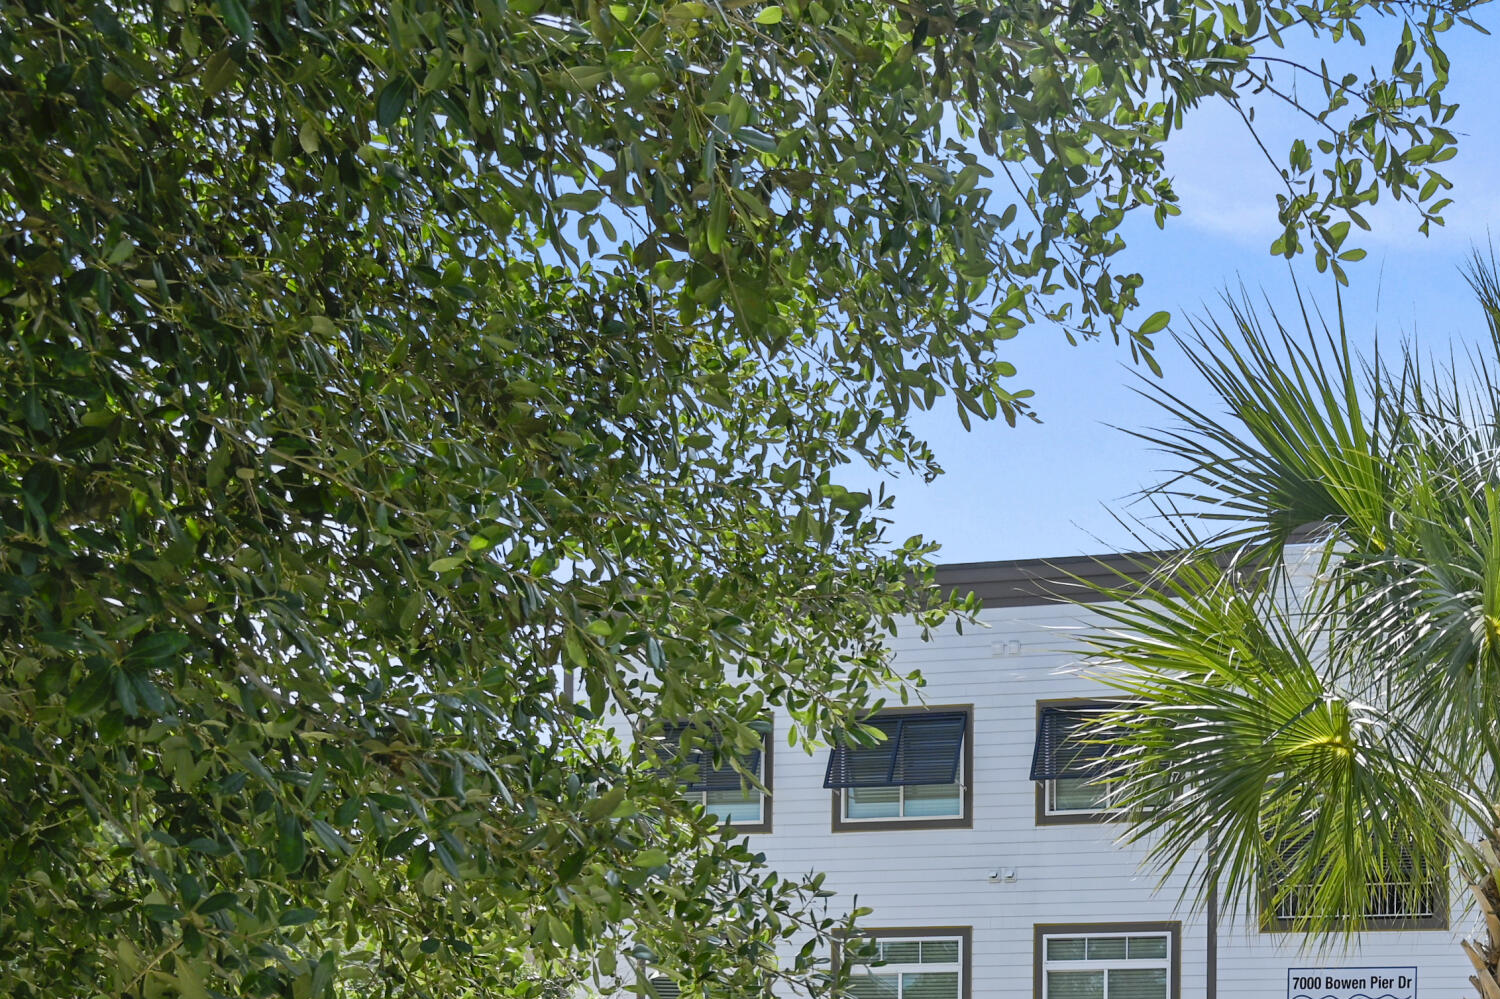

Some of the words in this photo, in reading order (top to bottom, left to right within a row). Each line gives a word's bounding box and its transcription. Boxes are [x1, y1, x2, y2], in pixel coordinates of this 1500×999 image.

[1292, 977, 1321, 989] 7000
[1325, 976, 1366, 989] Bowen
[1370, 976, 1394, 989] Pier
[1398, 975, 1412, 988] Dr
